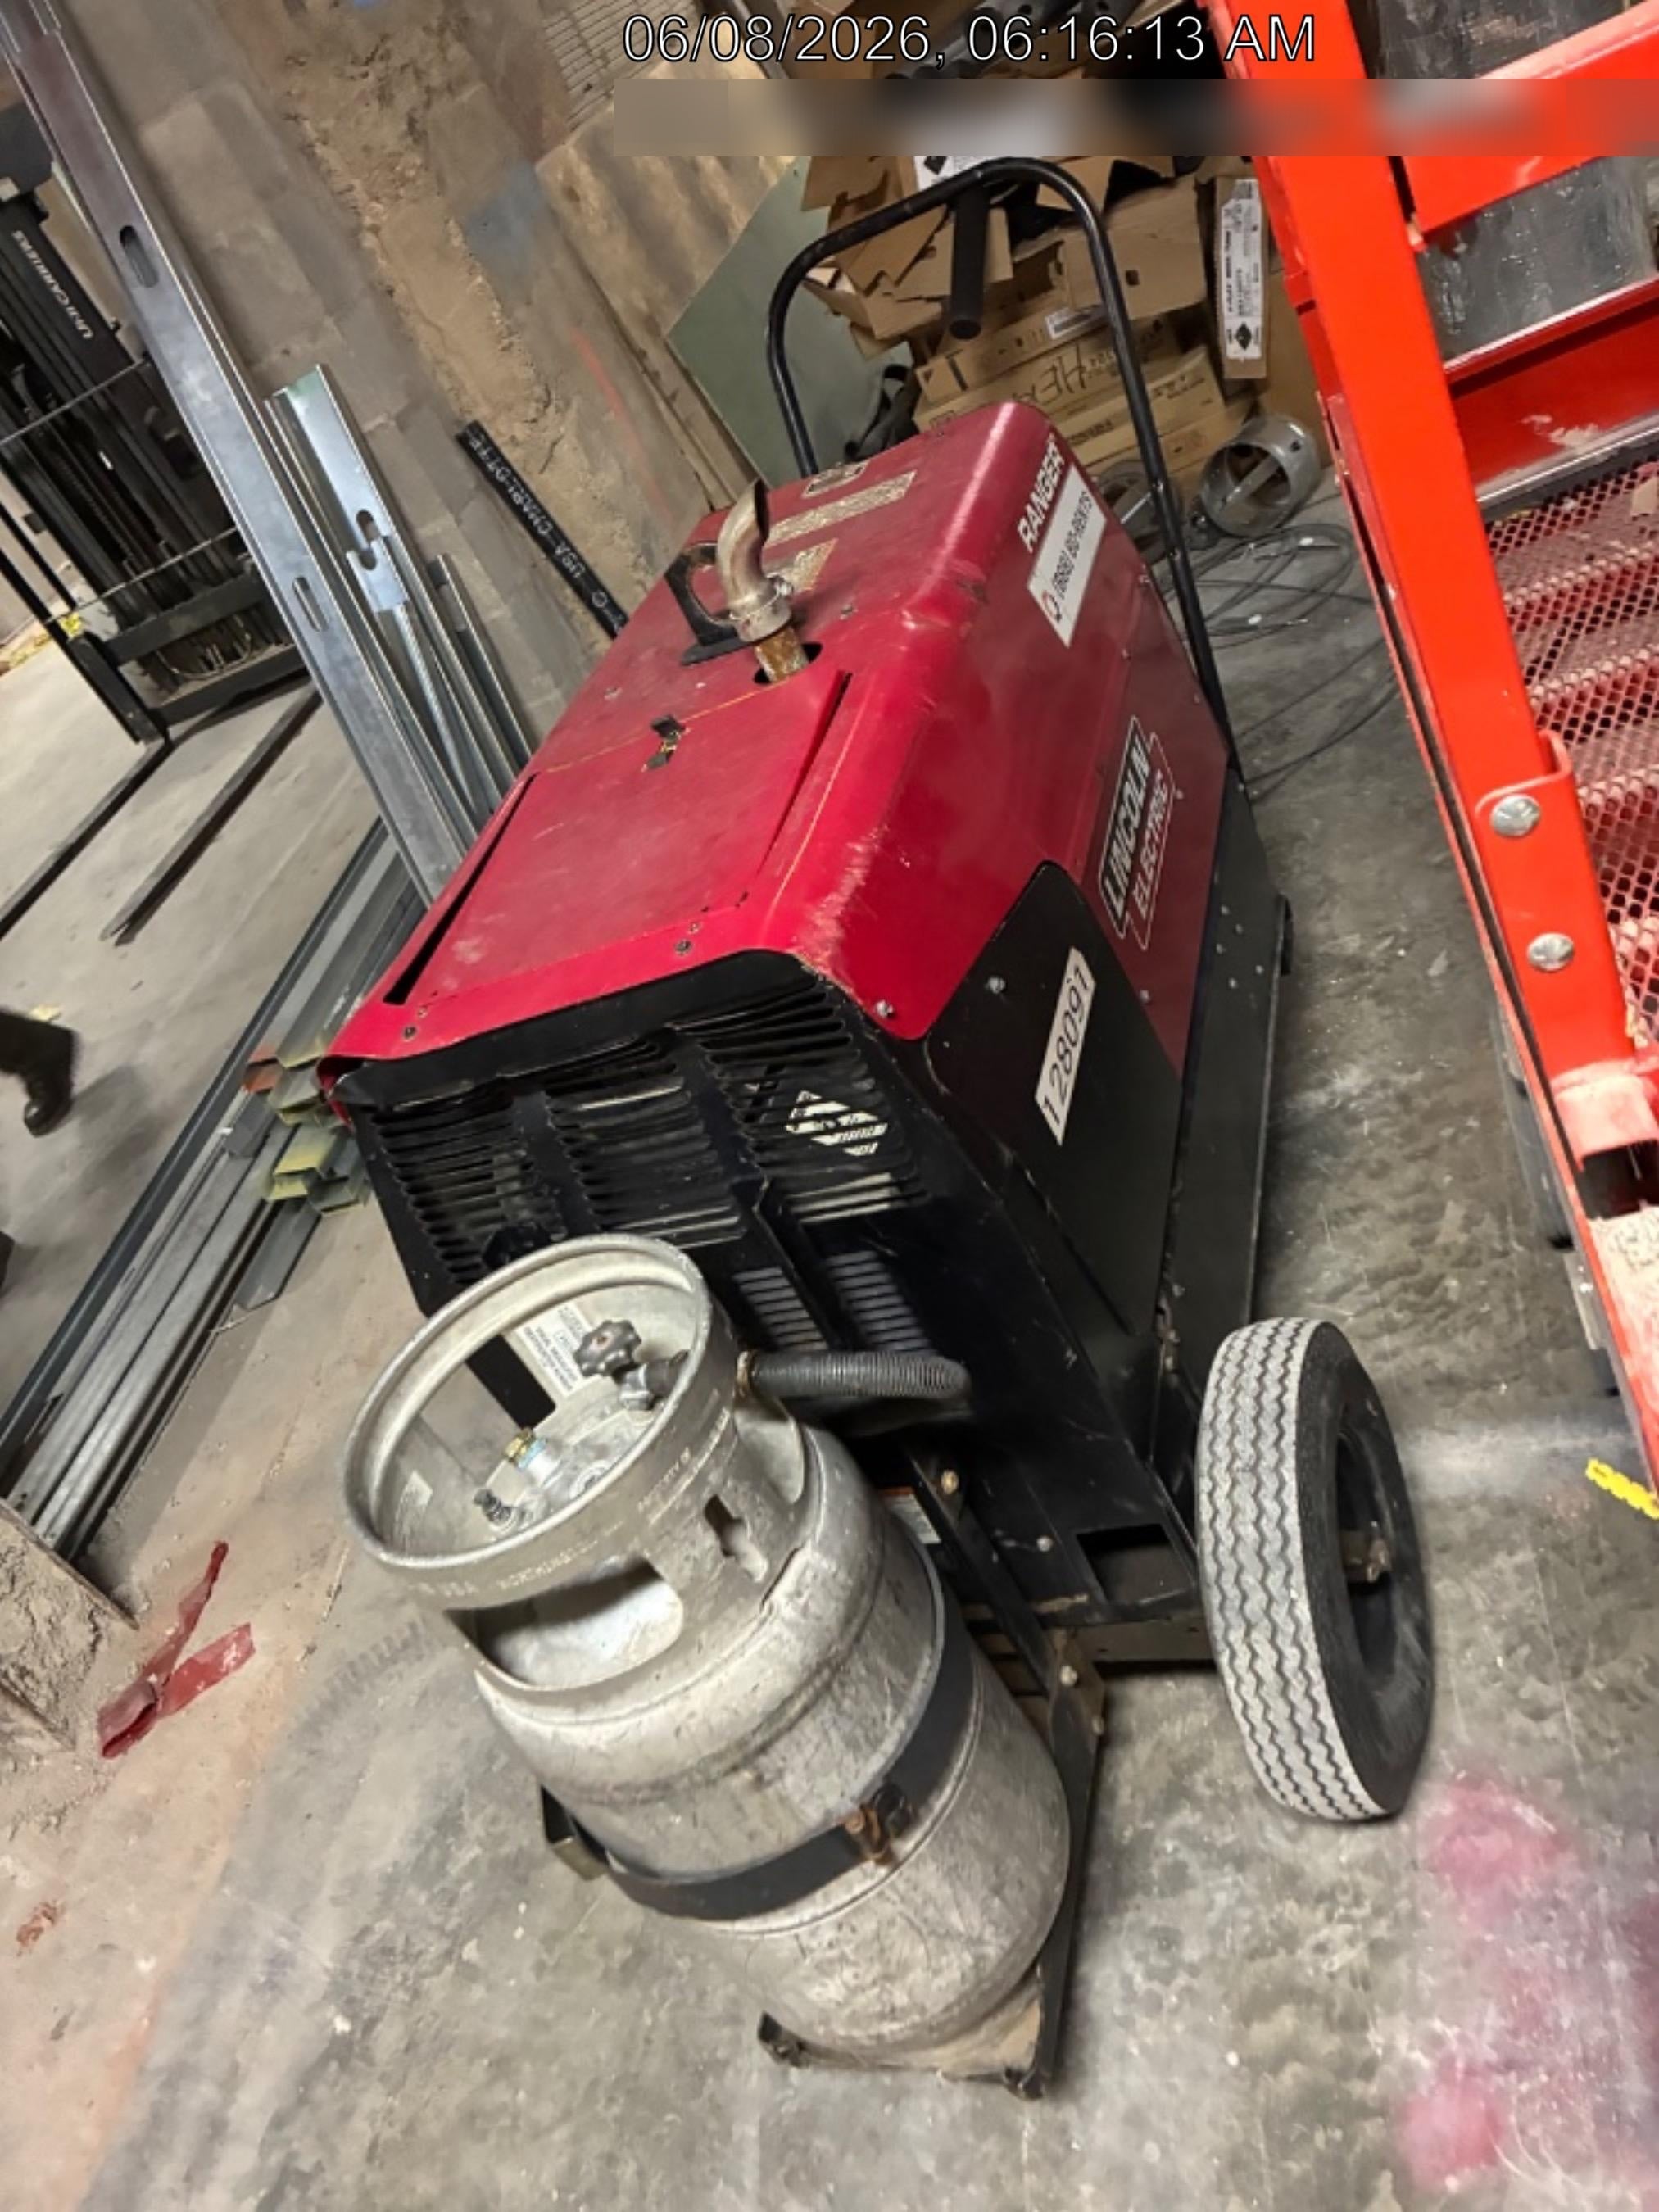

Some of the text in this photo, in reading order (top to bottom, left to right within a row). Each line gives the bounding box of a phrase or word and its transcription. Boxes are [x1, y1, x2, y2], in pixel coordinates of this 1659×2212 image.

[469, 433, 554, 534] CHARLOTTE
[1017, 439, 1064, 554] RANGER
[1105, 734, 1149, 918] LINCOLN
[1132, 772, 1168, 921] ELECTRIC
[1043, 966, 1089, 1126] 128091
